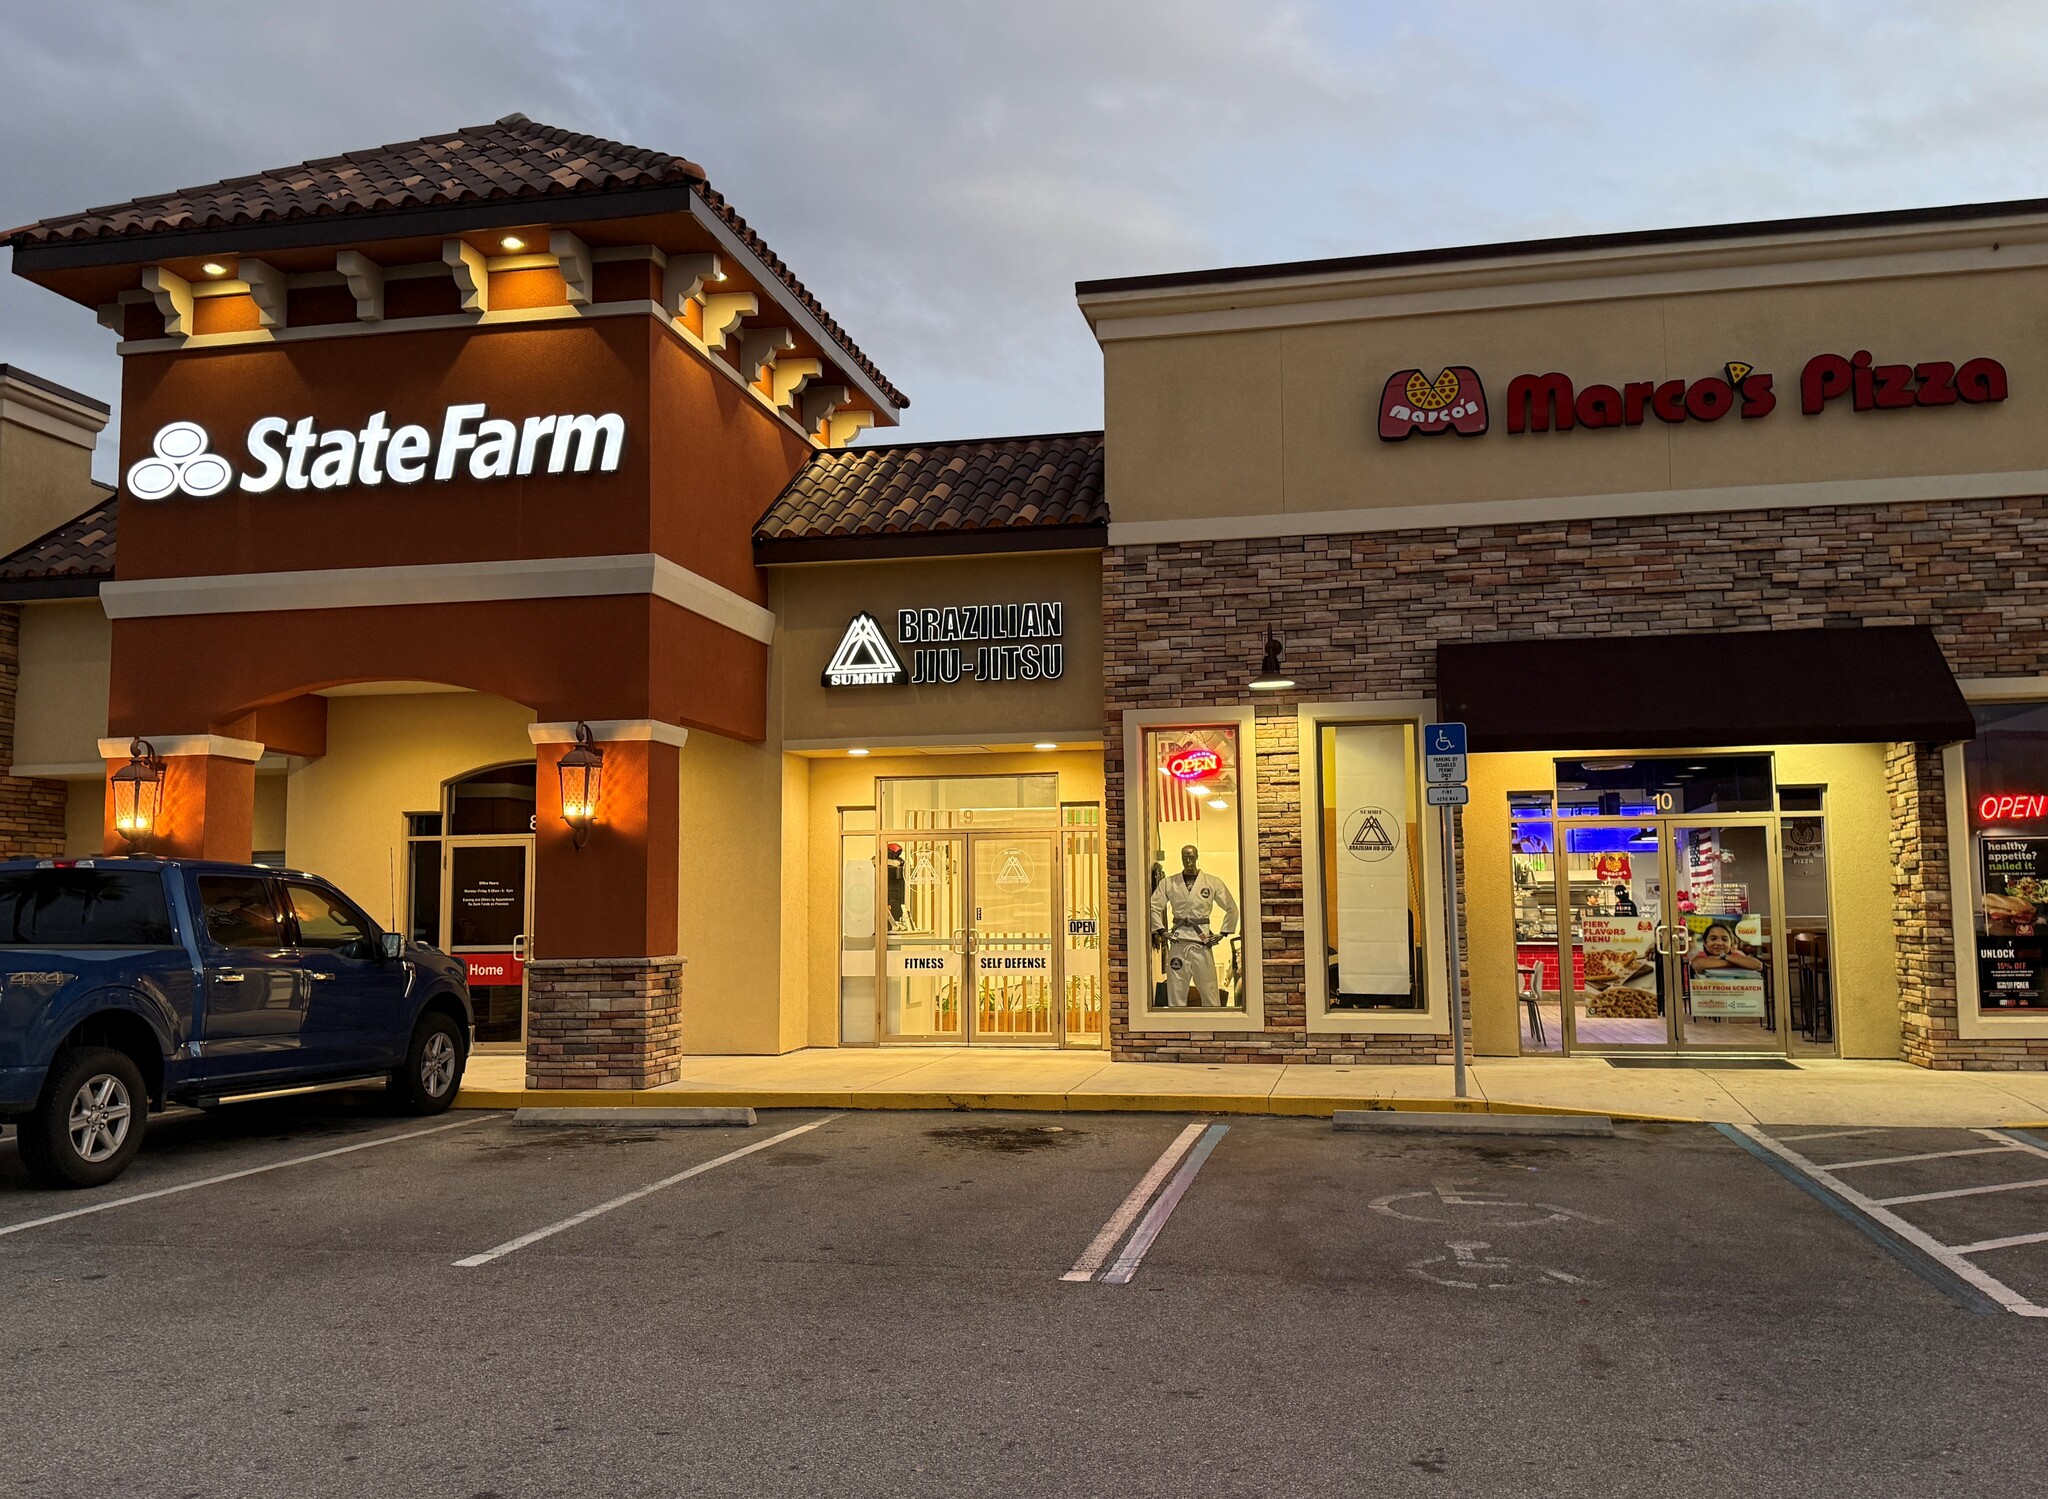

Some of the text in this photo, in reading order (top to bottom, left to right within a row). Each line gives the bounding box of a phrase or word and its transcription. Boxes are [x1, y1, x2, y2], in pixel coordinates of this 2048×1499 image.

[1801, 349, 2008, 416] Pizza
[898, 602, 1062, 643] BRAZILIAN
[911, 643, 1063, 683] JIU-JITSU
[831, 672, 896, 685] SUMMIT
[1171, 755, 1217, 774] OPEN
[1652, 792, 1673, 810] 10
[1981, 795, 2045, 819] OPEN
[963, 809, 974, 825] 9
[1987, 841, 2028, 852] healthy
[1988, 851, 2037, 863] appetite?
[1988, 861, 2036, 870] nailed it.
[1069, 920, 1096, 933] OPEN
[1583, 928, 1626, 936] FLAVORS
[1980, 949, 2016, 959] UNLOCK
[469, 963, 504, 976] Home
[904, 957, 944, 969] FITNESS
[980, 957, 1046, 969] SELF DEFENSE
